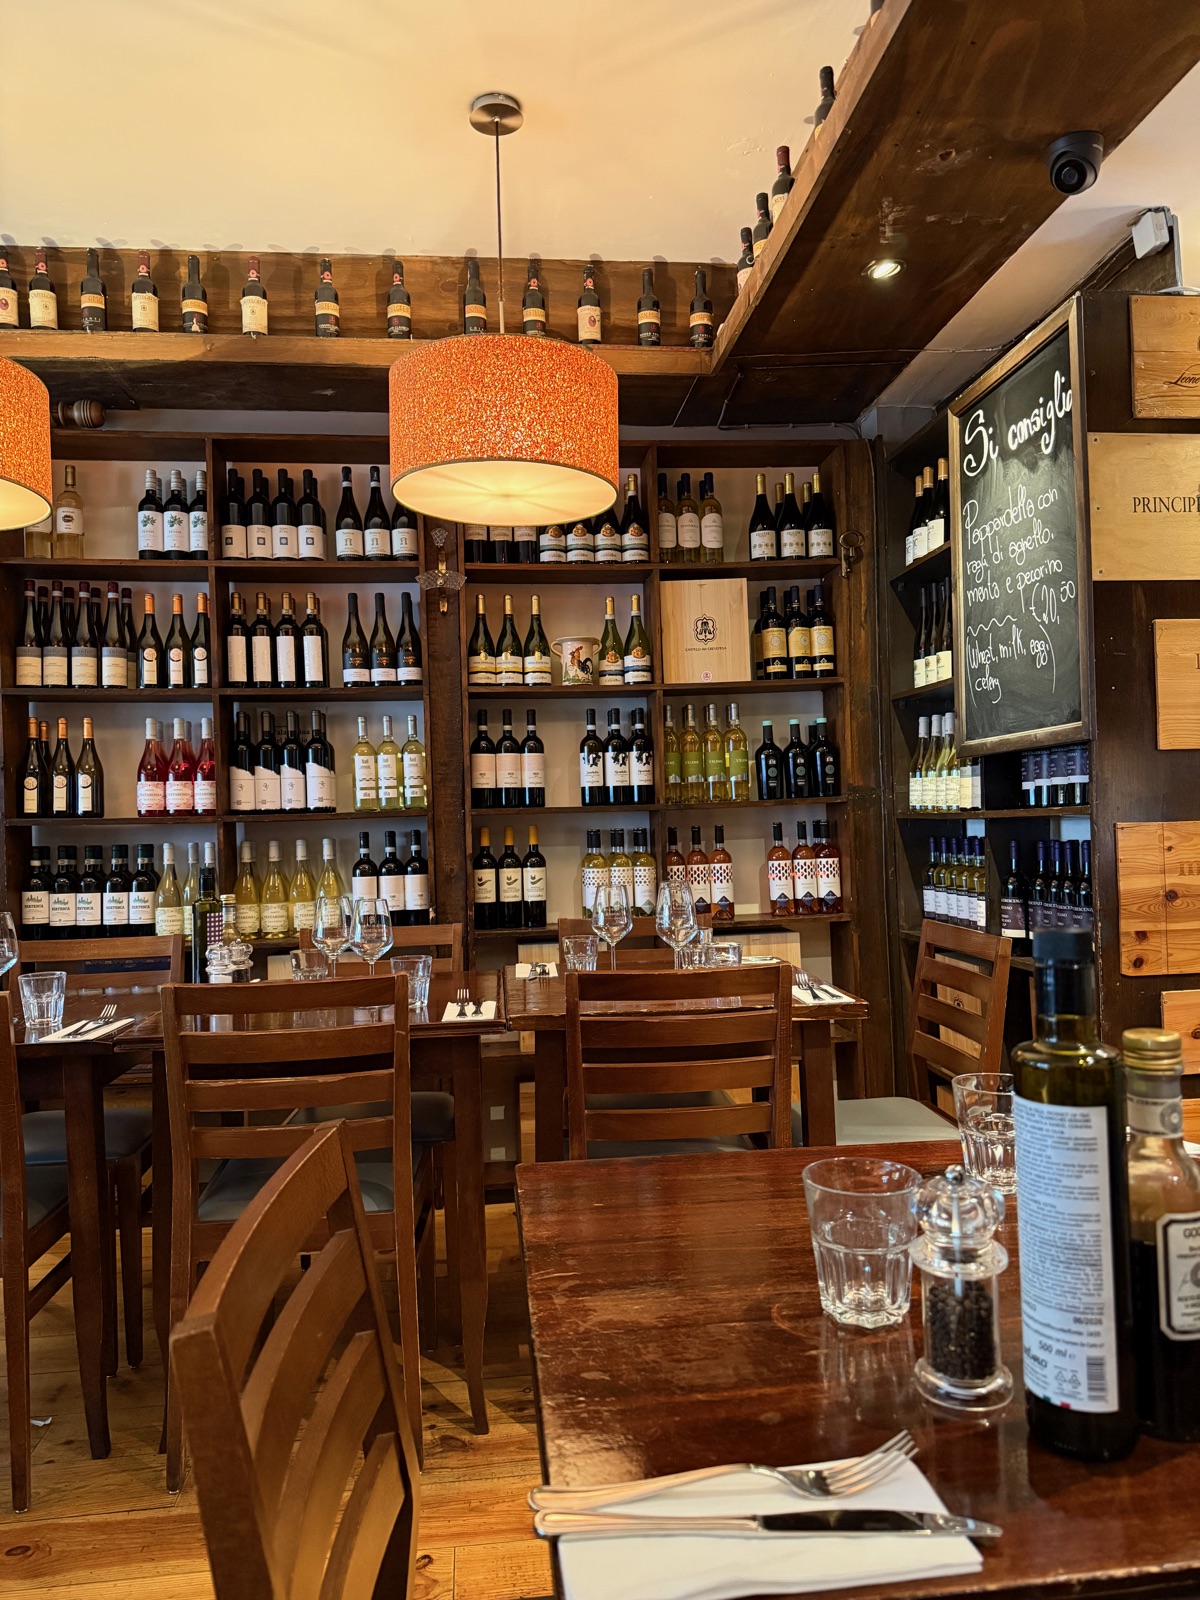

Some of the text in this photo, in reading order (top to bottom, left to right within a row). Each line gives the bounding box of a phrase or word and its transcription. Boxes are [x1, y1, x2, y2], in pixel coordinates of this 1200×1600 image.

[963, 409, 999, 477] Si
[1037, 488, 1059, 510] con
[992, 536, 1004, 564] di
[966, 570, 1000, 607] menta
[1006, 576, 1014, 593] e
[1055, 1347, 1067, 1358] ml
